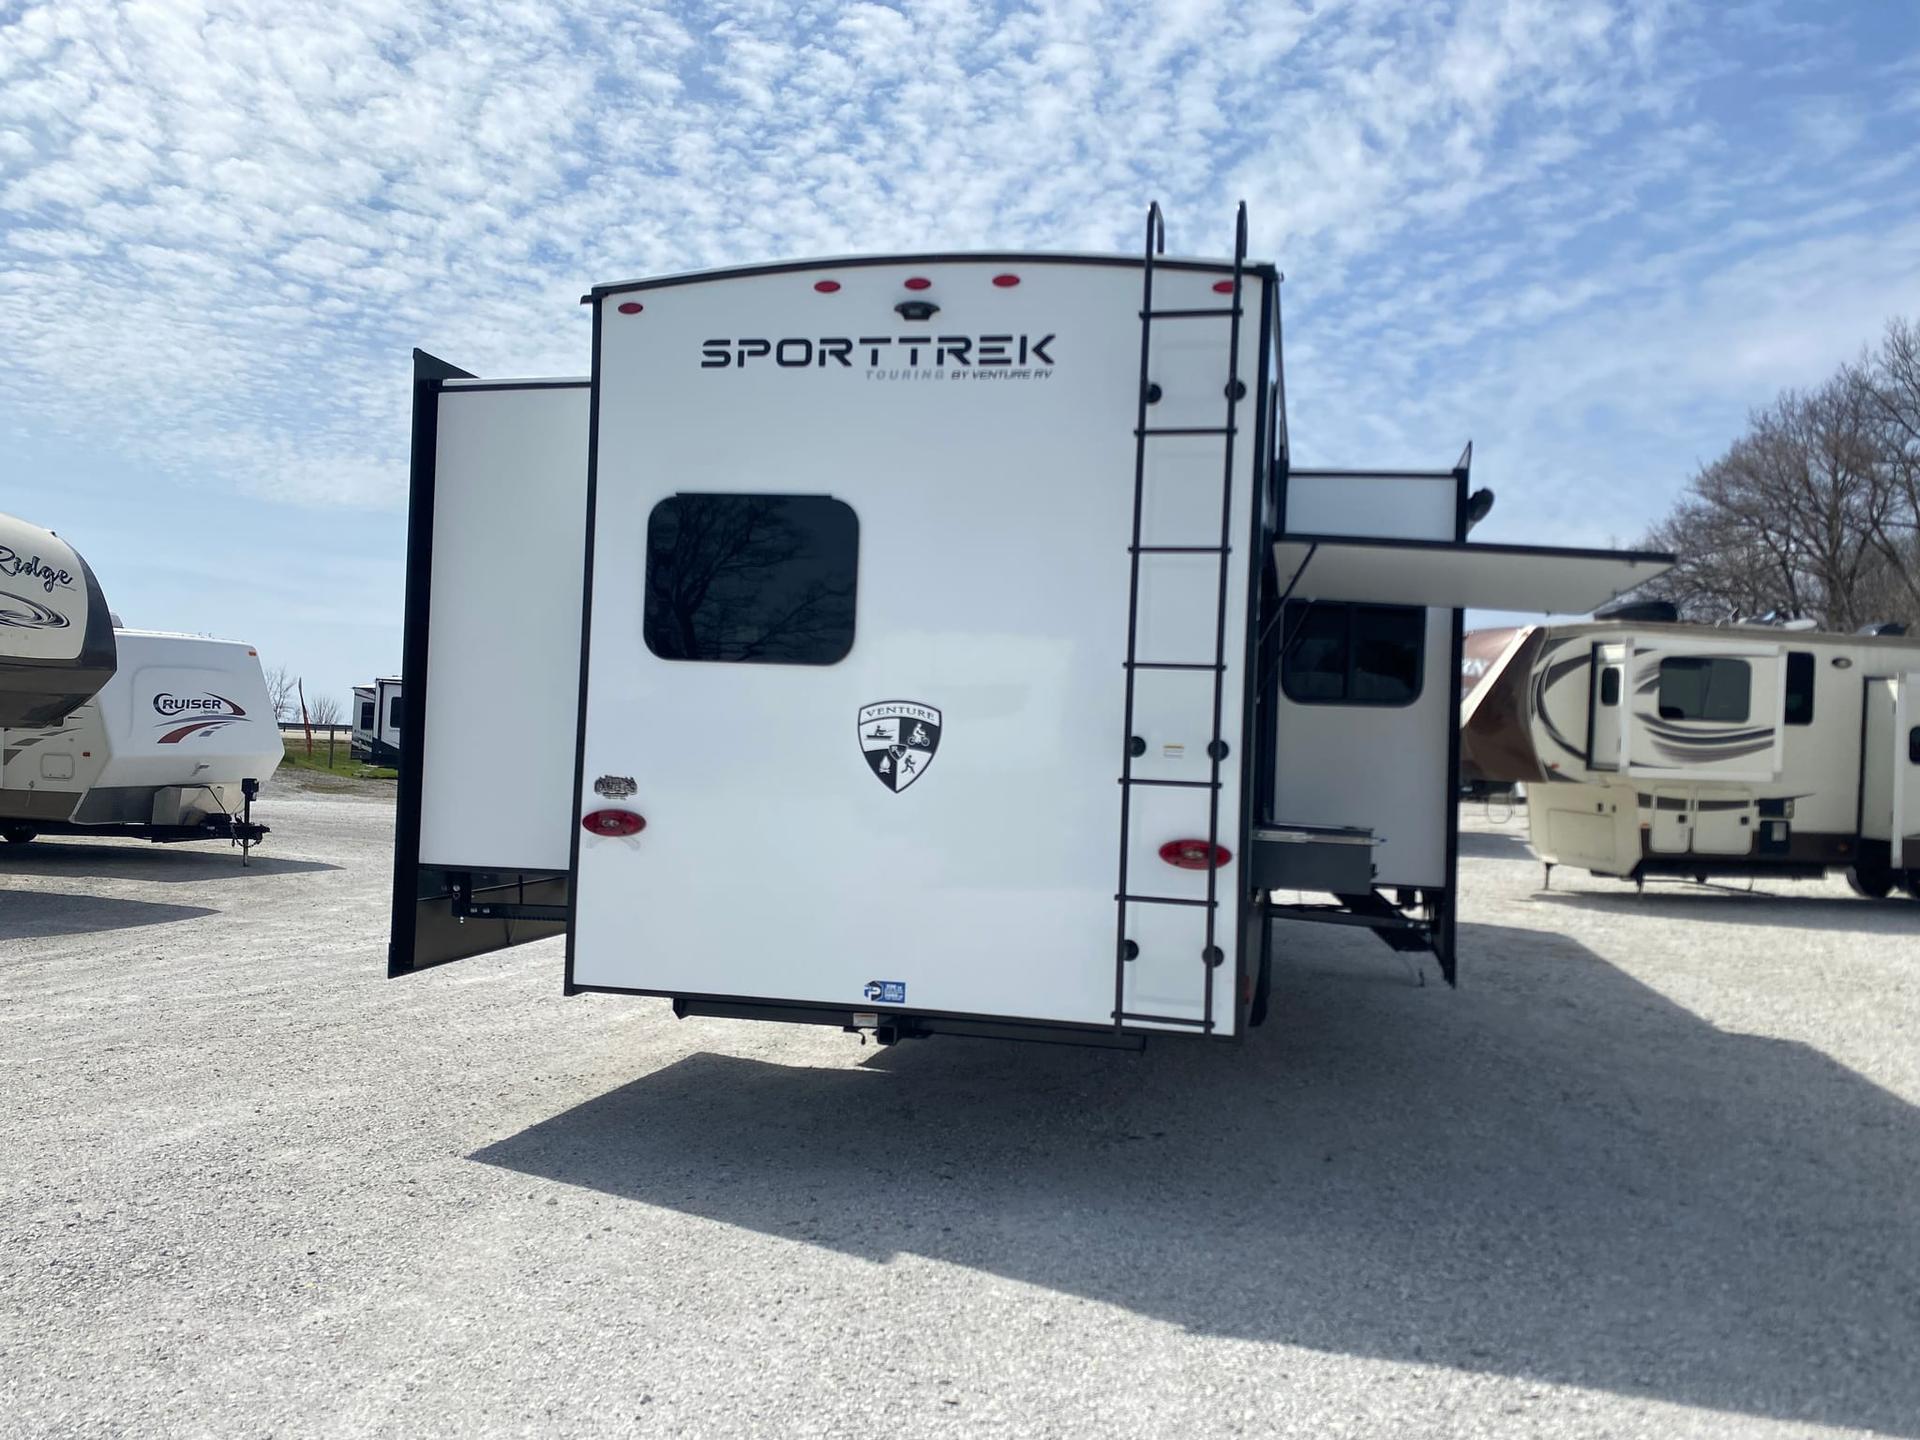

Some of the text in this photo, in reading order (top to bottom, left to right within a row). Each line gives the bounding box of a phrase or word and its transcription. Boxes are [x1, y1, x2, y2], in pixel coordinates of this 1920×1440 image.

[701, 334, 1055, 368] SPORTTREK
[866, 369, 1053, 380] TOURING BY VENTURE RV
[0, 545, 73, 593] Ridge
[153, 693, 221, 716] CRUISER
[866, 706, 935, 720] VENTURE
